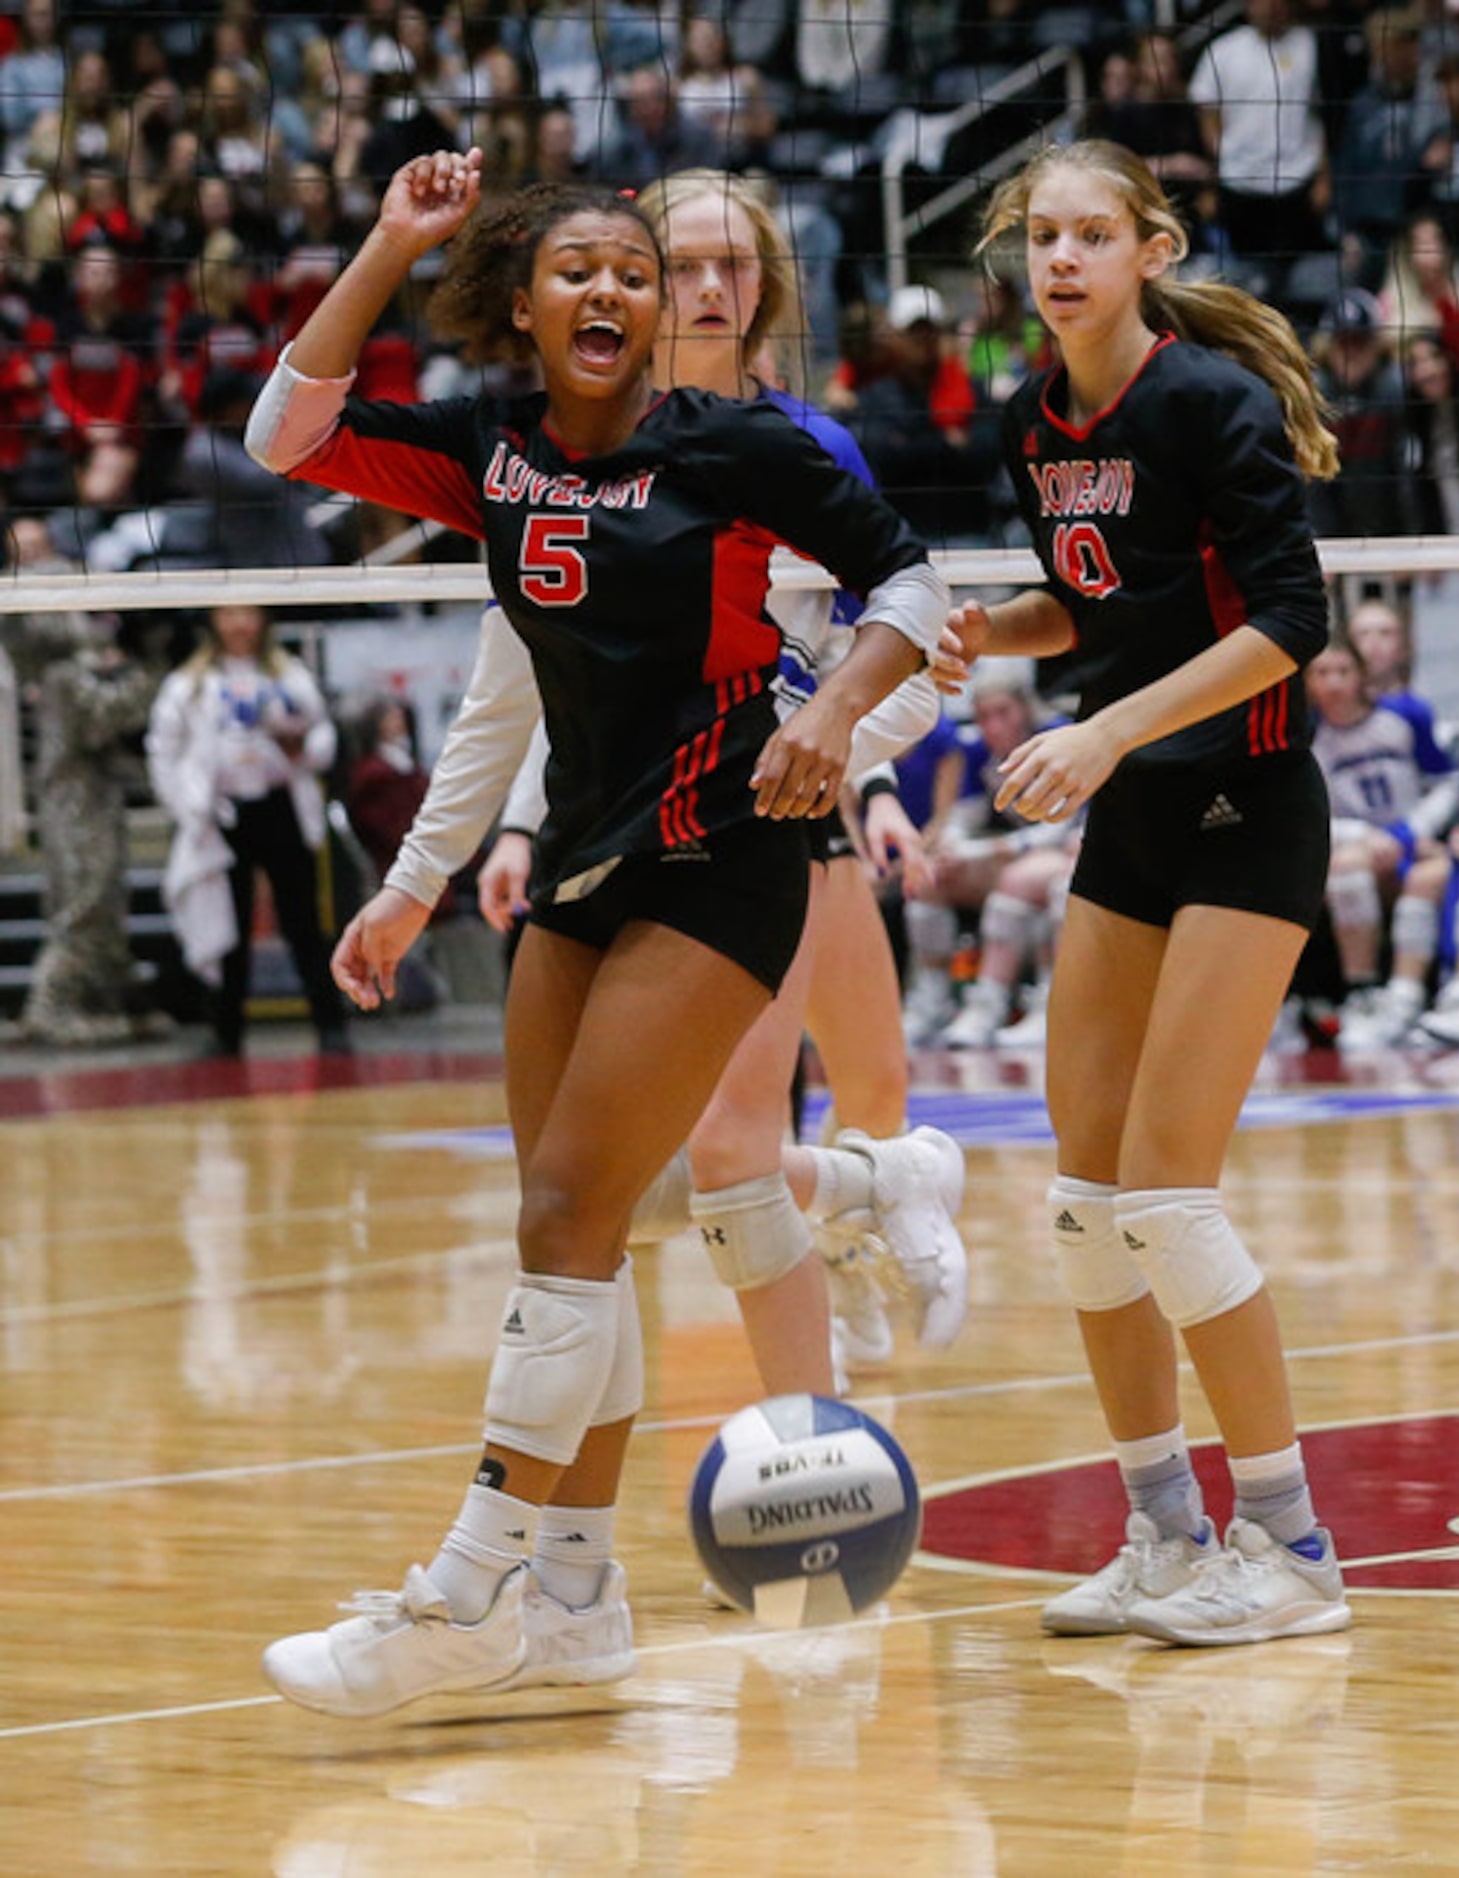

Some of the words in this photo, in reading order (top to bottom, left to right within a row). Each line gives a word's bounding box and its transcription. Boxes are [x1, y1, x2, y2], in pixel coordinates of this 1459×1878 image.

[518, 513, 591, 609] 5
[1053, 522, 1122, 600] 10
[747, 1482, 875, 1536] SPALDING
